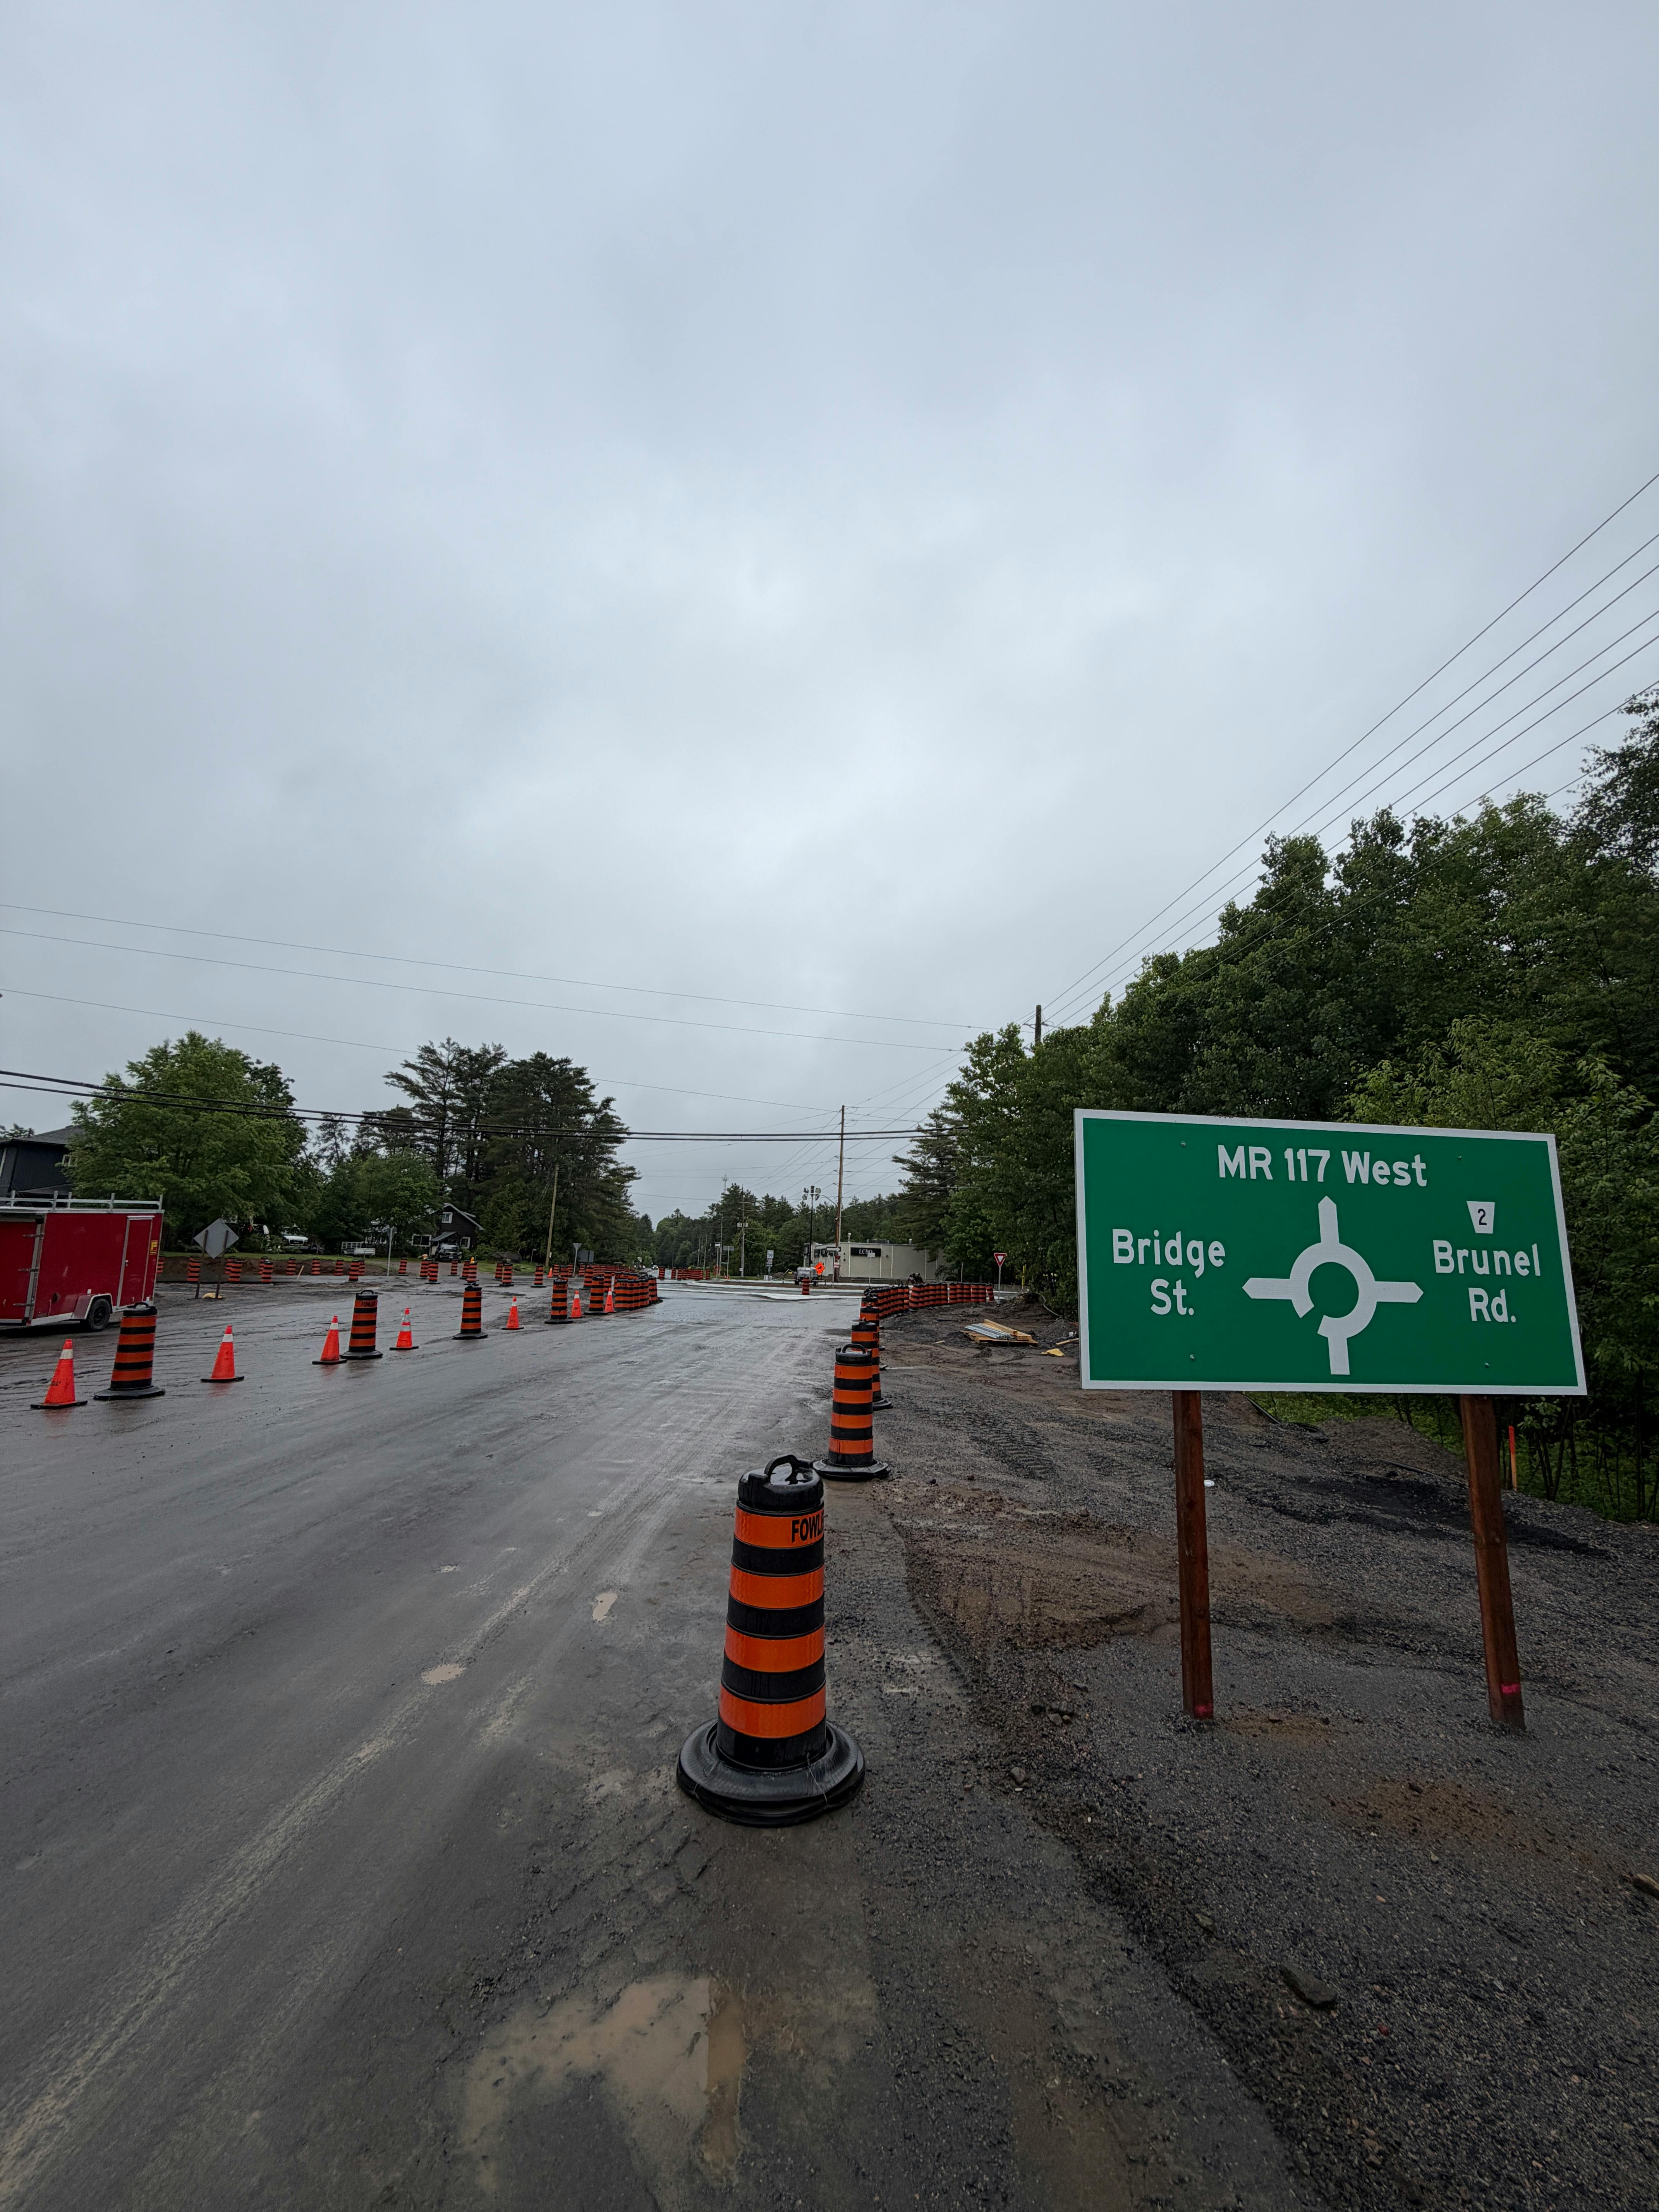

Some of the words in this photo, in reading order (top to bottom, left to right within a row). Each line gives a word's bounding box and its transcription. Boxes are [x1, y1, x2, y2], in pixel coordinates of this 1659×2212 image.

[1218, 1145, 1273, 1180] MR
[1284, 1148, 1330, 1182] 117
[1341, 1151, 1427, 1187] West
[1477, 1208, 1487, 1226] 2
[1112, 1229, 1225, 1278] Bridge
[1433, 1240, 1540, 1276] Brunel
[1151, 1278, 1194, 1316] St.
[1468, 1287, 1516, 1323] Rd.
